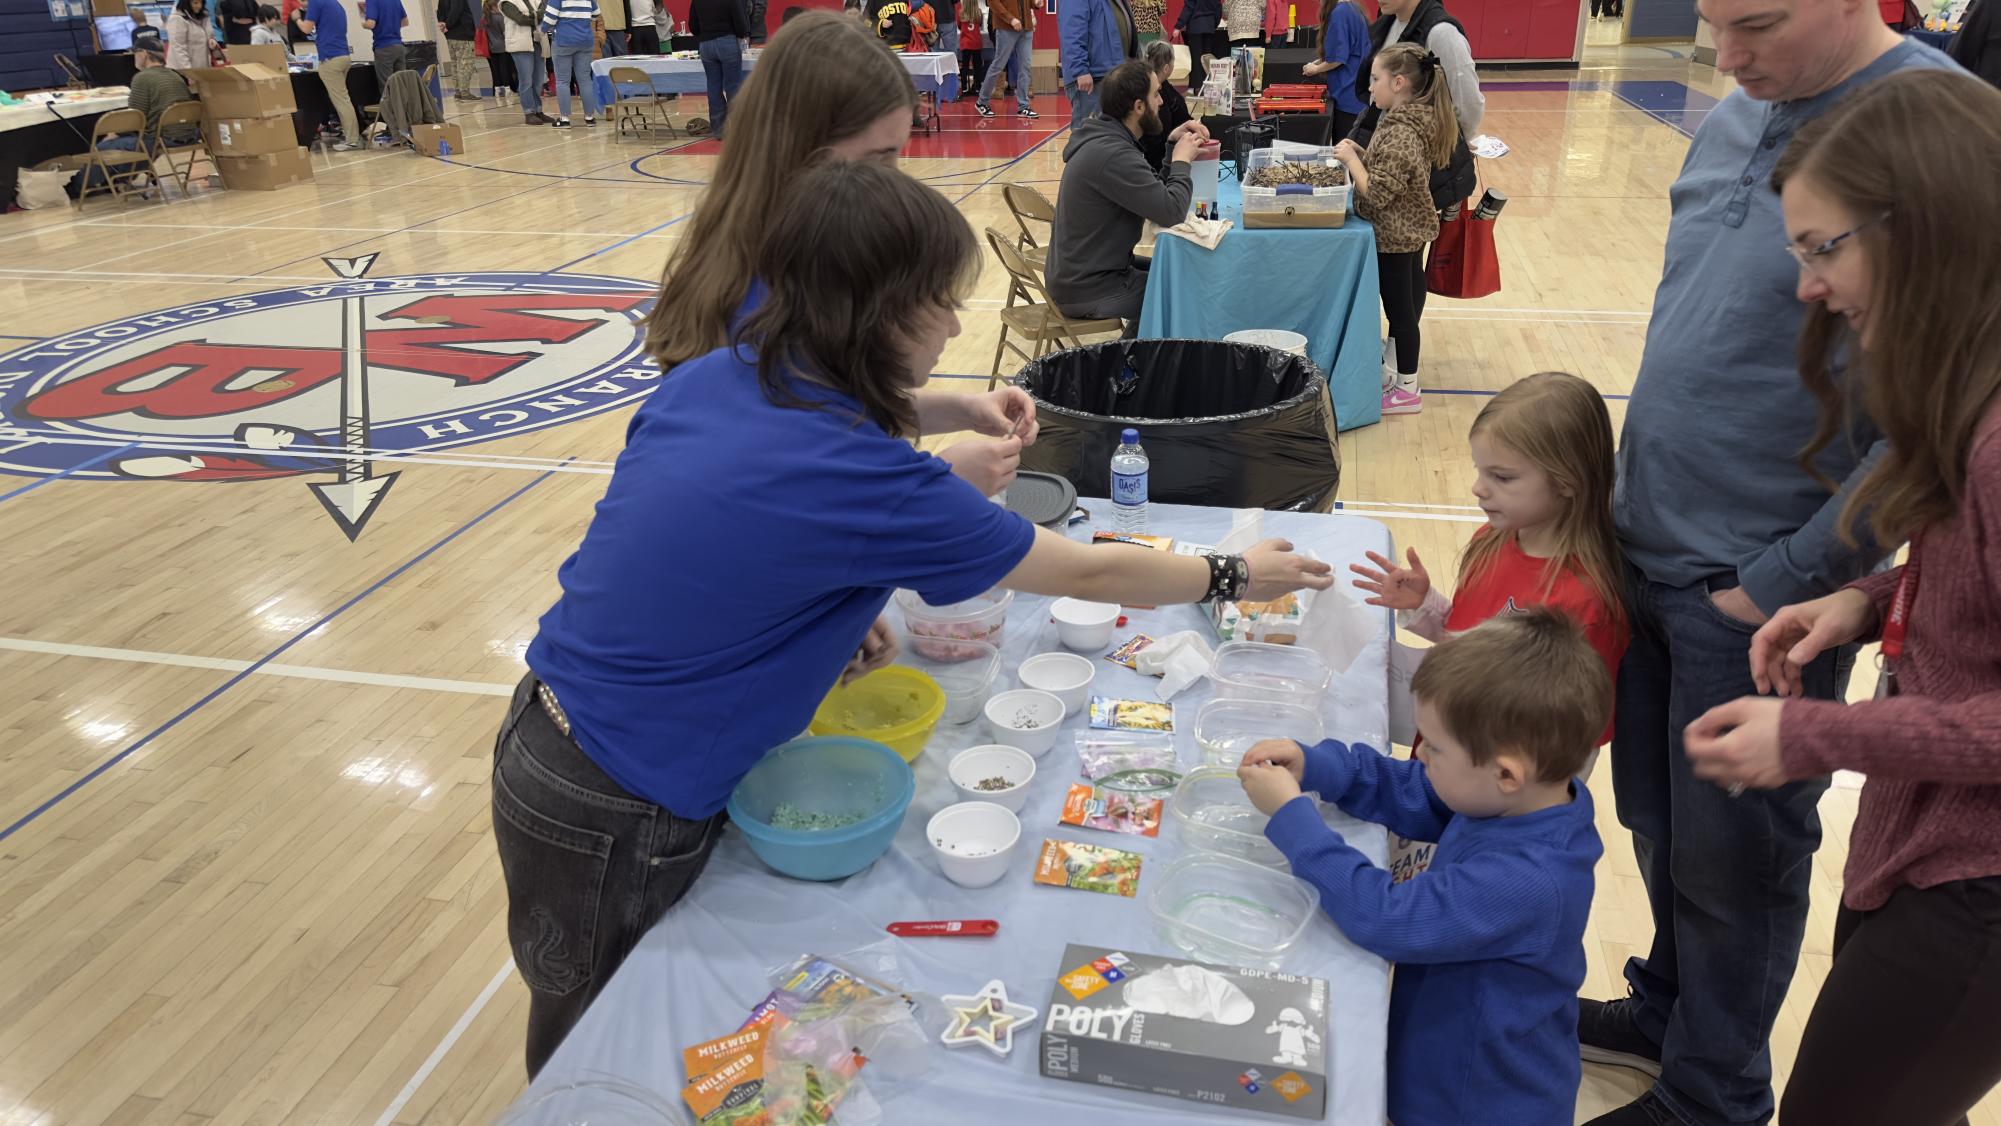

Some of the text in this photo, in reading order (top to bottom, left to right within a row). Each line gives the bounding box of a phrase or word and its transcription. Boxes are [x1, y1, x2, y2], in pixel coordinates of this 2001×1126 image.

[878, 2, 907, 19] BOSTO
[19, 299, 258, 362] SCHOOL
[1119, 478, 1141, 494] OASIS
[1390, 844, 1432, 875] EAM
[1045, 1003, 1135, 1042] POLY
[698, 1031, 760, 1058] MILKWEED
[1047, 1034, 1068, 1072] POLY
[696, 1053, 755, 1095] MILKWEED
